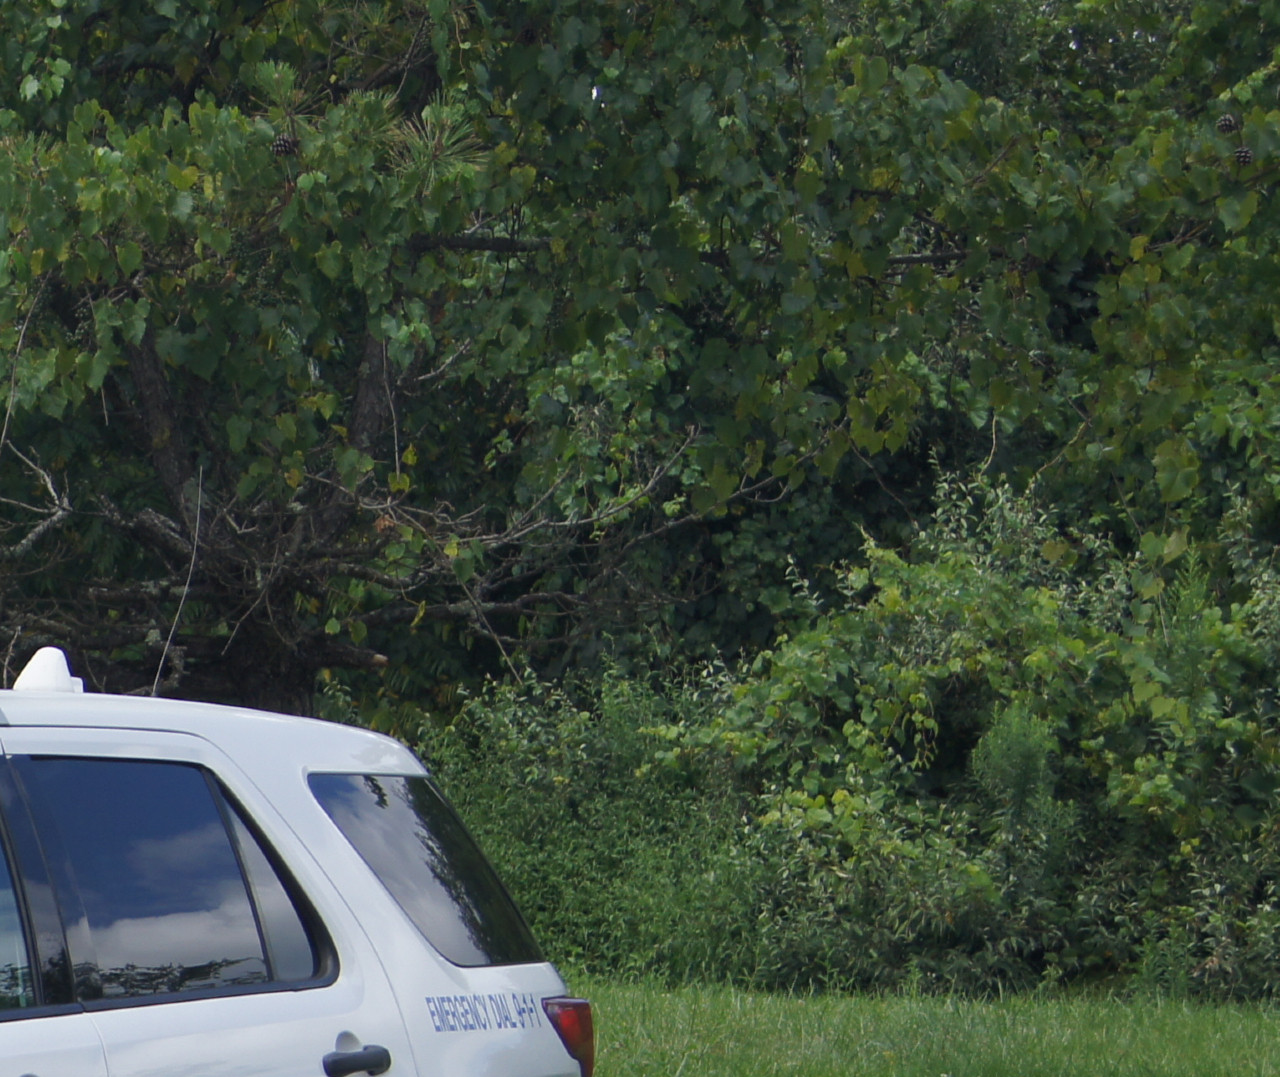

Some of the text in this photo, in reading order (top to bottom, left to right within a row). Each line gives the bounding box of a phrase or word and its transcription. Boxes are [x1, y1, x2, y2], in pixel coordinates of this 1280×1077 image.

[425, 992, 542, 1032] EMERGENCY DIAL 9-1-1
